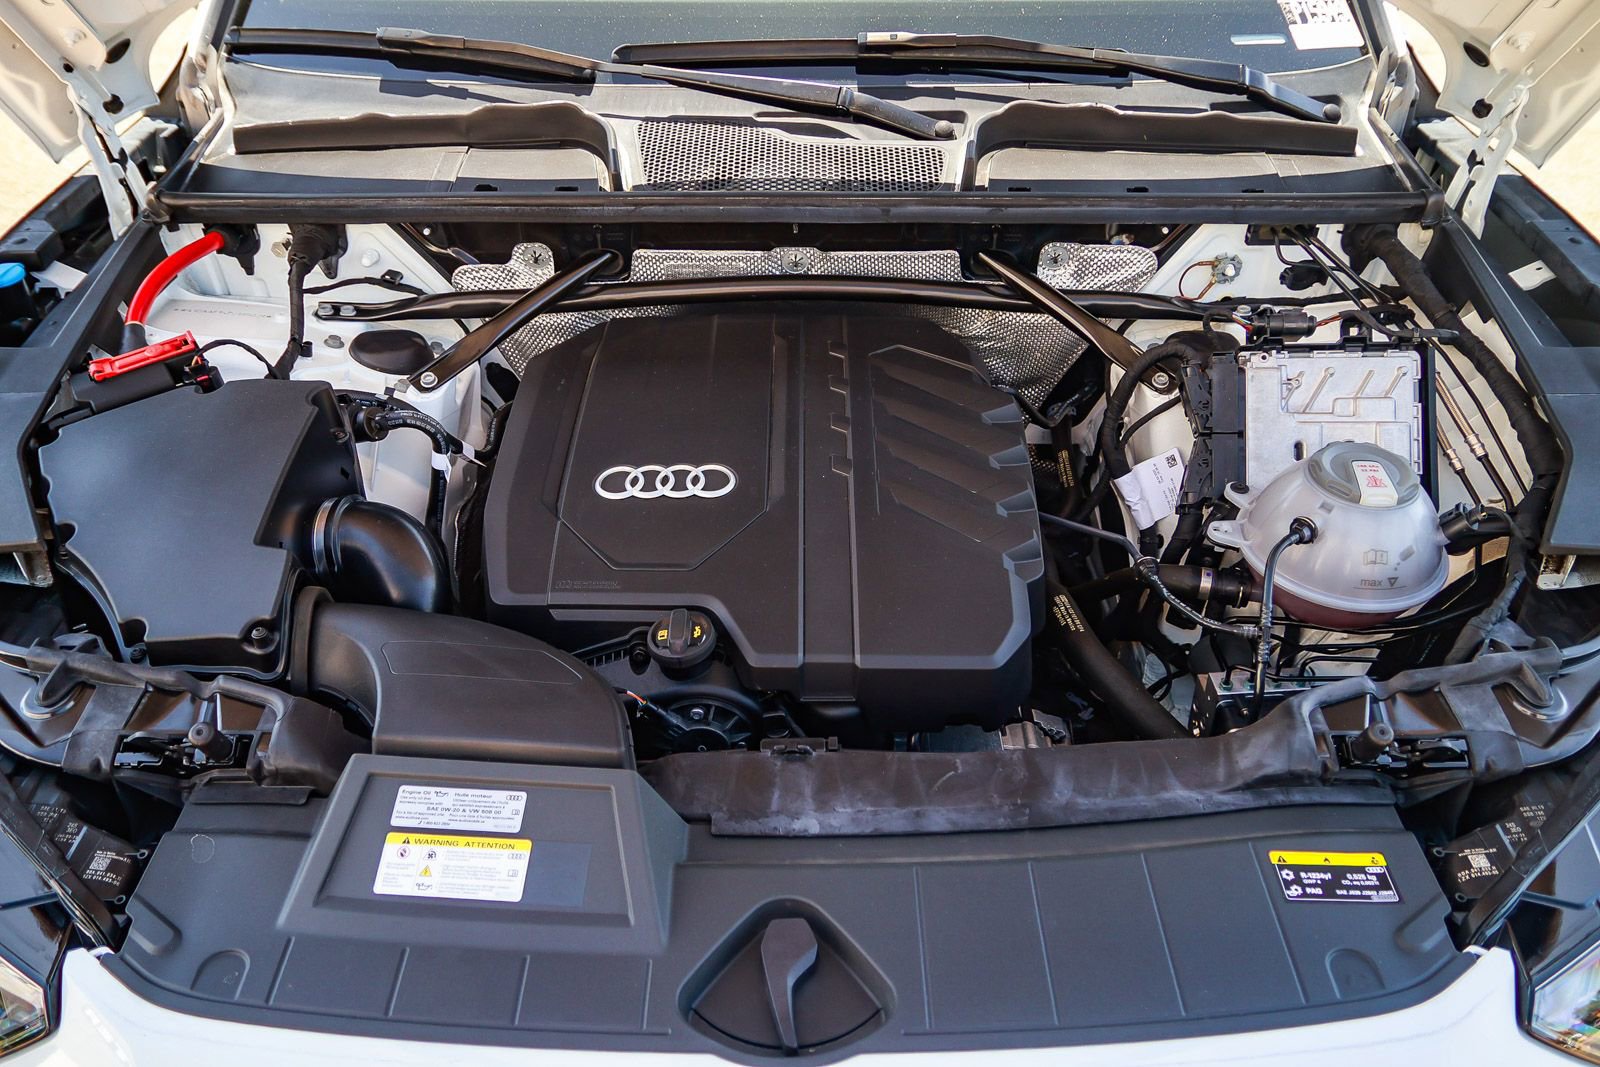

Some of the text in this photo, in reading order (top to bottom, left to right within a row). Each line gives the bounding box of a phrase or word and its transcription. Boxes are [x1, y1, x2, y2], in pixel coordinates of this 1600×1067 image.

[1360, 578, 1383, 587] max
[414, 838, 515, 850] WARNING ATTENTION
[1299, 871, 1332, 880] R-1234yf
[1367, 874, 1378, 882] kg
[1305, 887, 1324, 895] PAG
